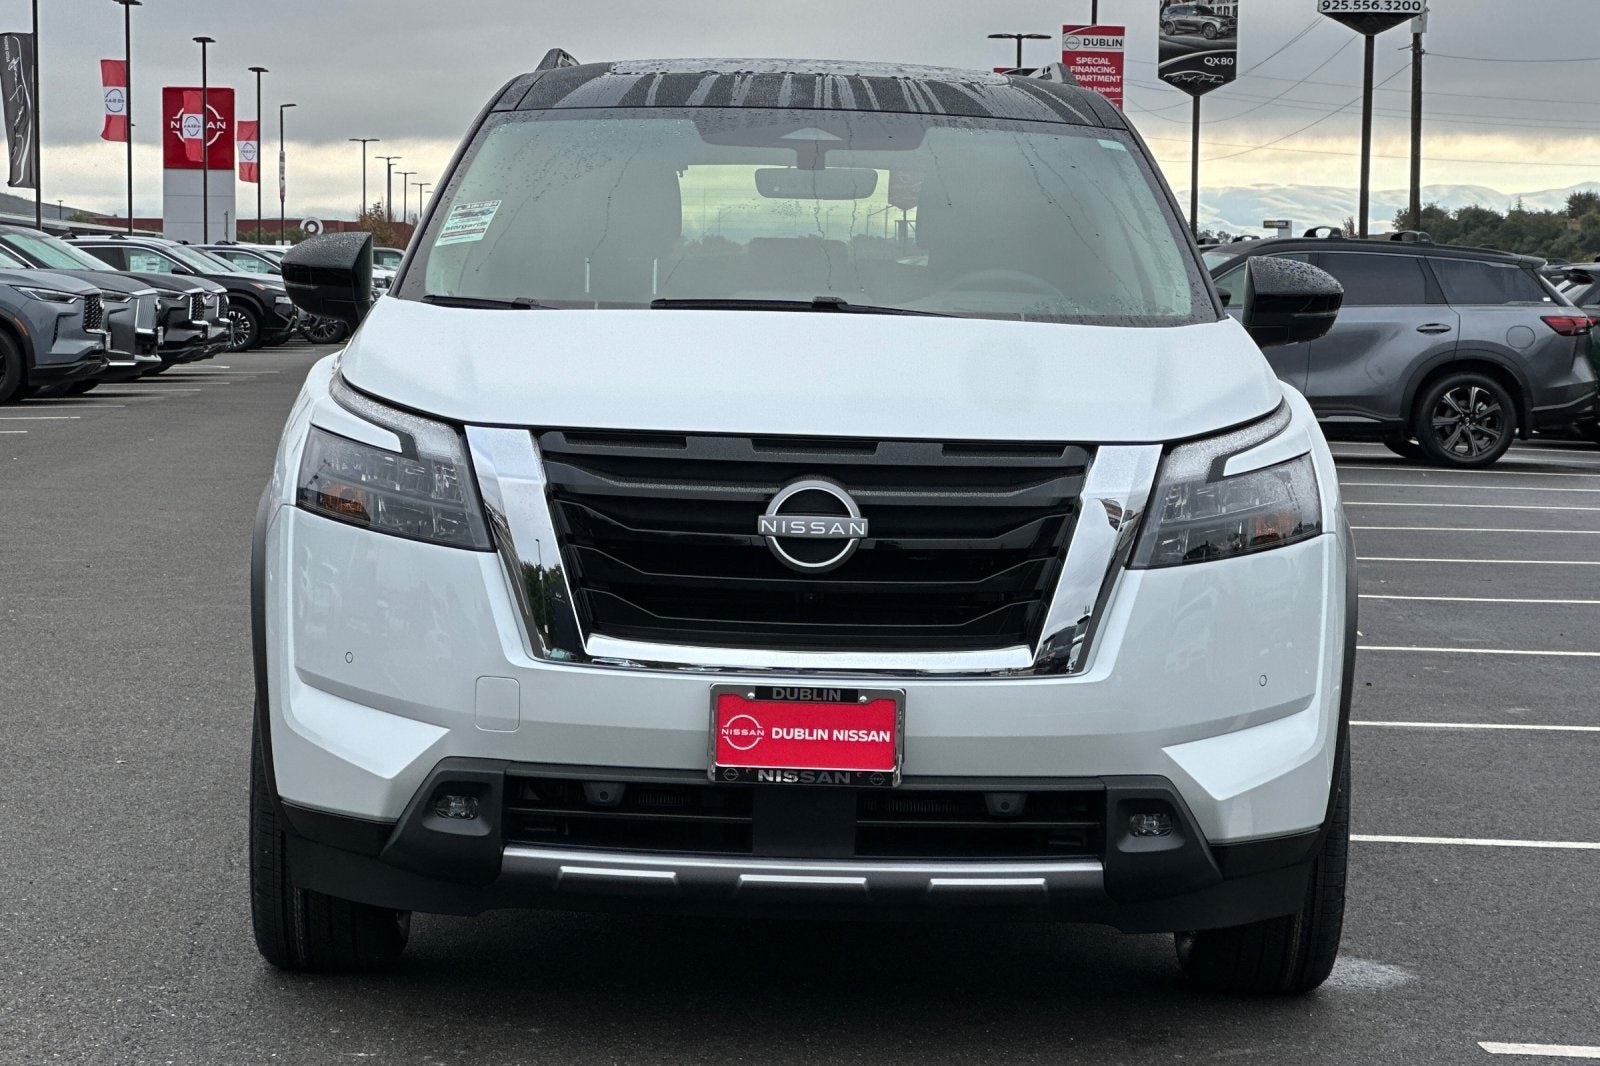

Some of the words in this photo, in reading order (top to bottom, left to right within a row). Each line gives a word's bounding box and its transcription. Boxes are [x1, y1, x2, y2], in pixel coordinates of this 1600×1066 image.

[1322, 0, 1421, 11] 925.556.3200
[1083, 38, 1123, 47] DUBLIN
[1204, 56, 1234, 66] QX80
[1070, 65, 1116, 73] FINANCING
[1074, 74, 1122, 82] PARTMENT
[170, 121, 226, 129] NAN
[761, 519, 865, 535] NISSAN
[772, 687, 841, 701] DUBLIN
[721, 728, 764, 736] NISSAN
[771, 727, 828, 740] DUBLIN
[833, 729, 891, 742] NISSAN
[757, 769, 851, 784] NISSAN
